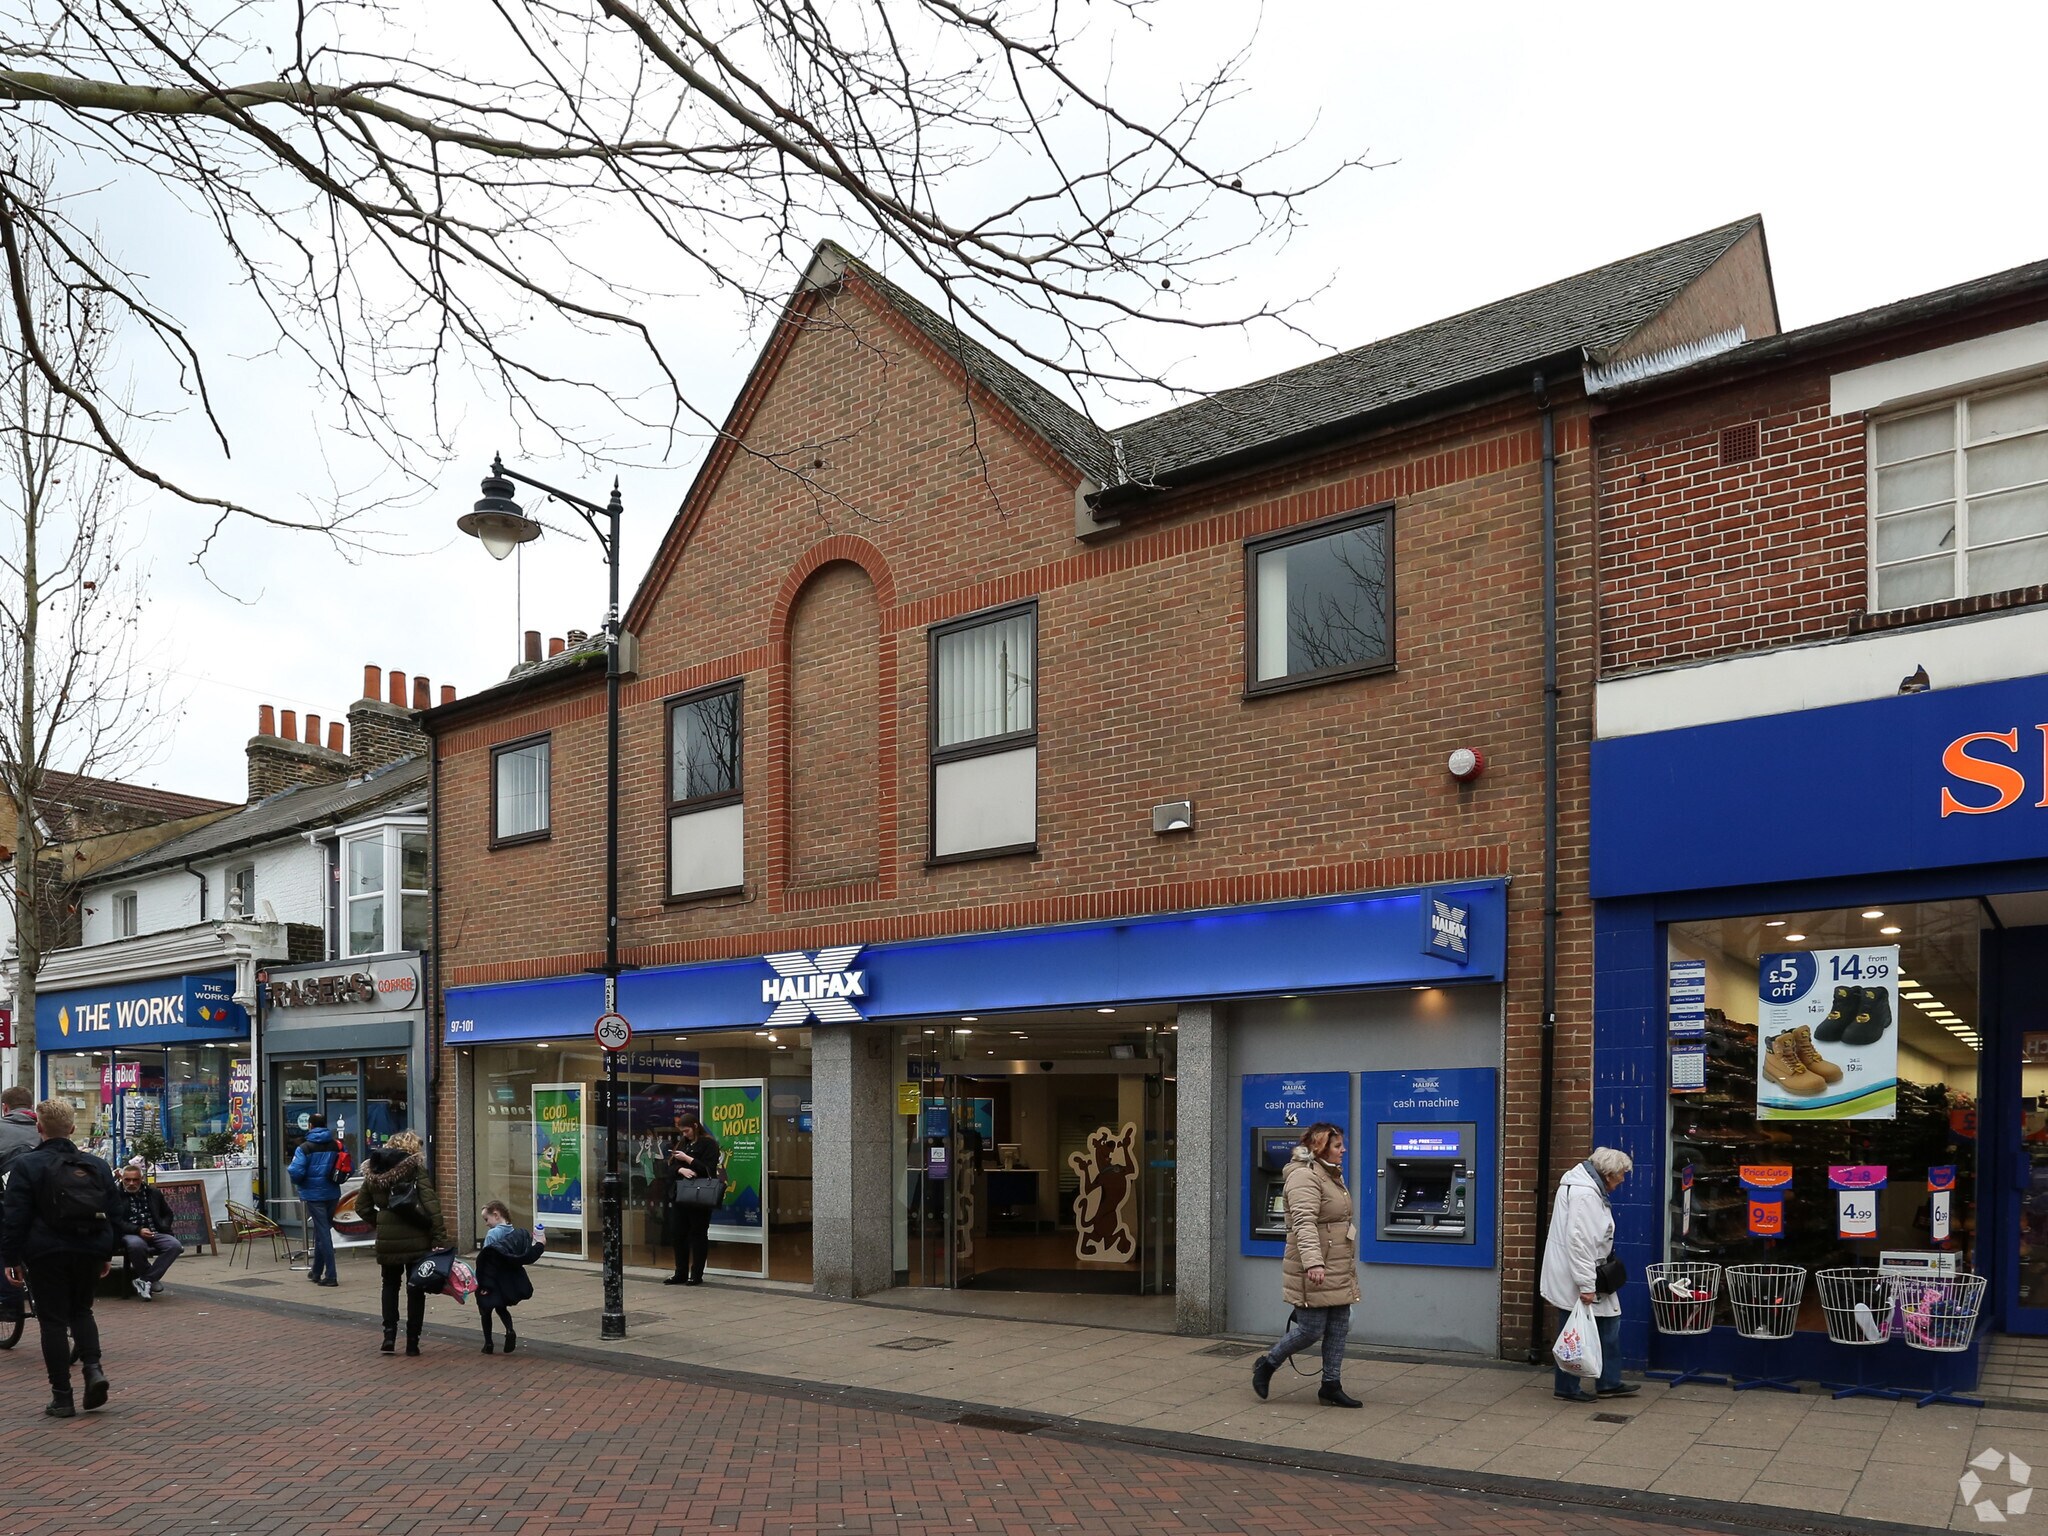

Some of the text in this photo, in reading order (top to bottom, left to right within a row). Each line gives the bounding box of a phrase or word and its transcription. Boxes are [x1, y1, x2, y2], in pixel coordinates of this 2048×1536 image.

[1431, 914, 1467, 939] HALIFAX
[1867, 954, 1888, 962] from
[1769, 958, 1798, 983] £5
[1829, 954, 1889, 981] 14.99
[202, 984, 222, 992] THE
[377, 977, 415, 993] COFFEE
[762, 971, 865, 1003] HALIFAX
[1771, 983, 1797, 997] off
[194, 992, 230, 1001] WORKS
[75, 1002, 111, 1032] THE
[450, 1019, 474, 1033] 97-101
[638, 1053, 682, 1069] service
[232, 1079, 250, 1093] KIDS
[1264, 1099, 1325, 1110] cash machine
[1393, 1096, 1460, 1108] cash machine
[231, 1096, 244, 1131] 5
[543, 1104, 568, 1121] GOOD
[711, 1103, 745, 1121] GOOD
[551, 1117, 579, 1135] MOVE!
[722, 1116, 760, 1137] MOVE!
[1743, 1168, 1789, 1177] Price Cuts
[1752, 1207, 1779, 1223] 9.99
[1843, 1203, 1872, 1219] 4.99
[1934, 1205, 1948, 1222] 6.99
